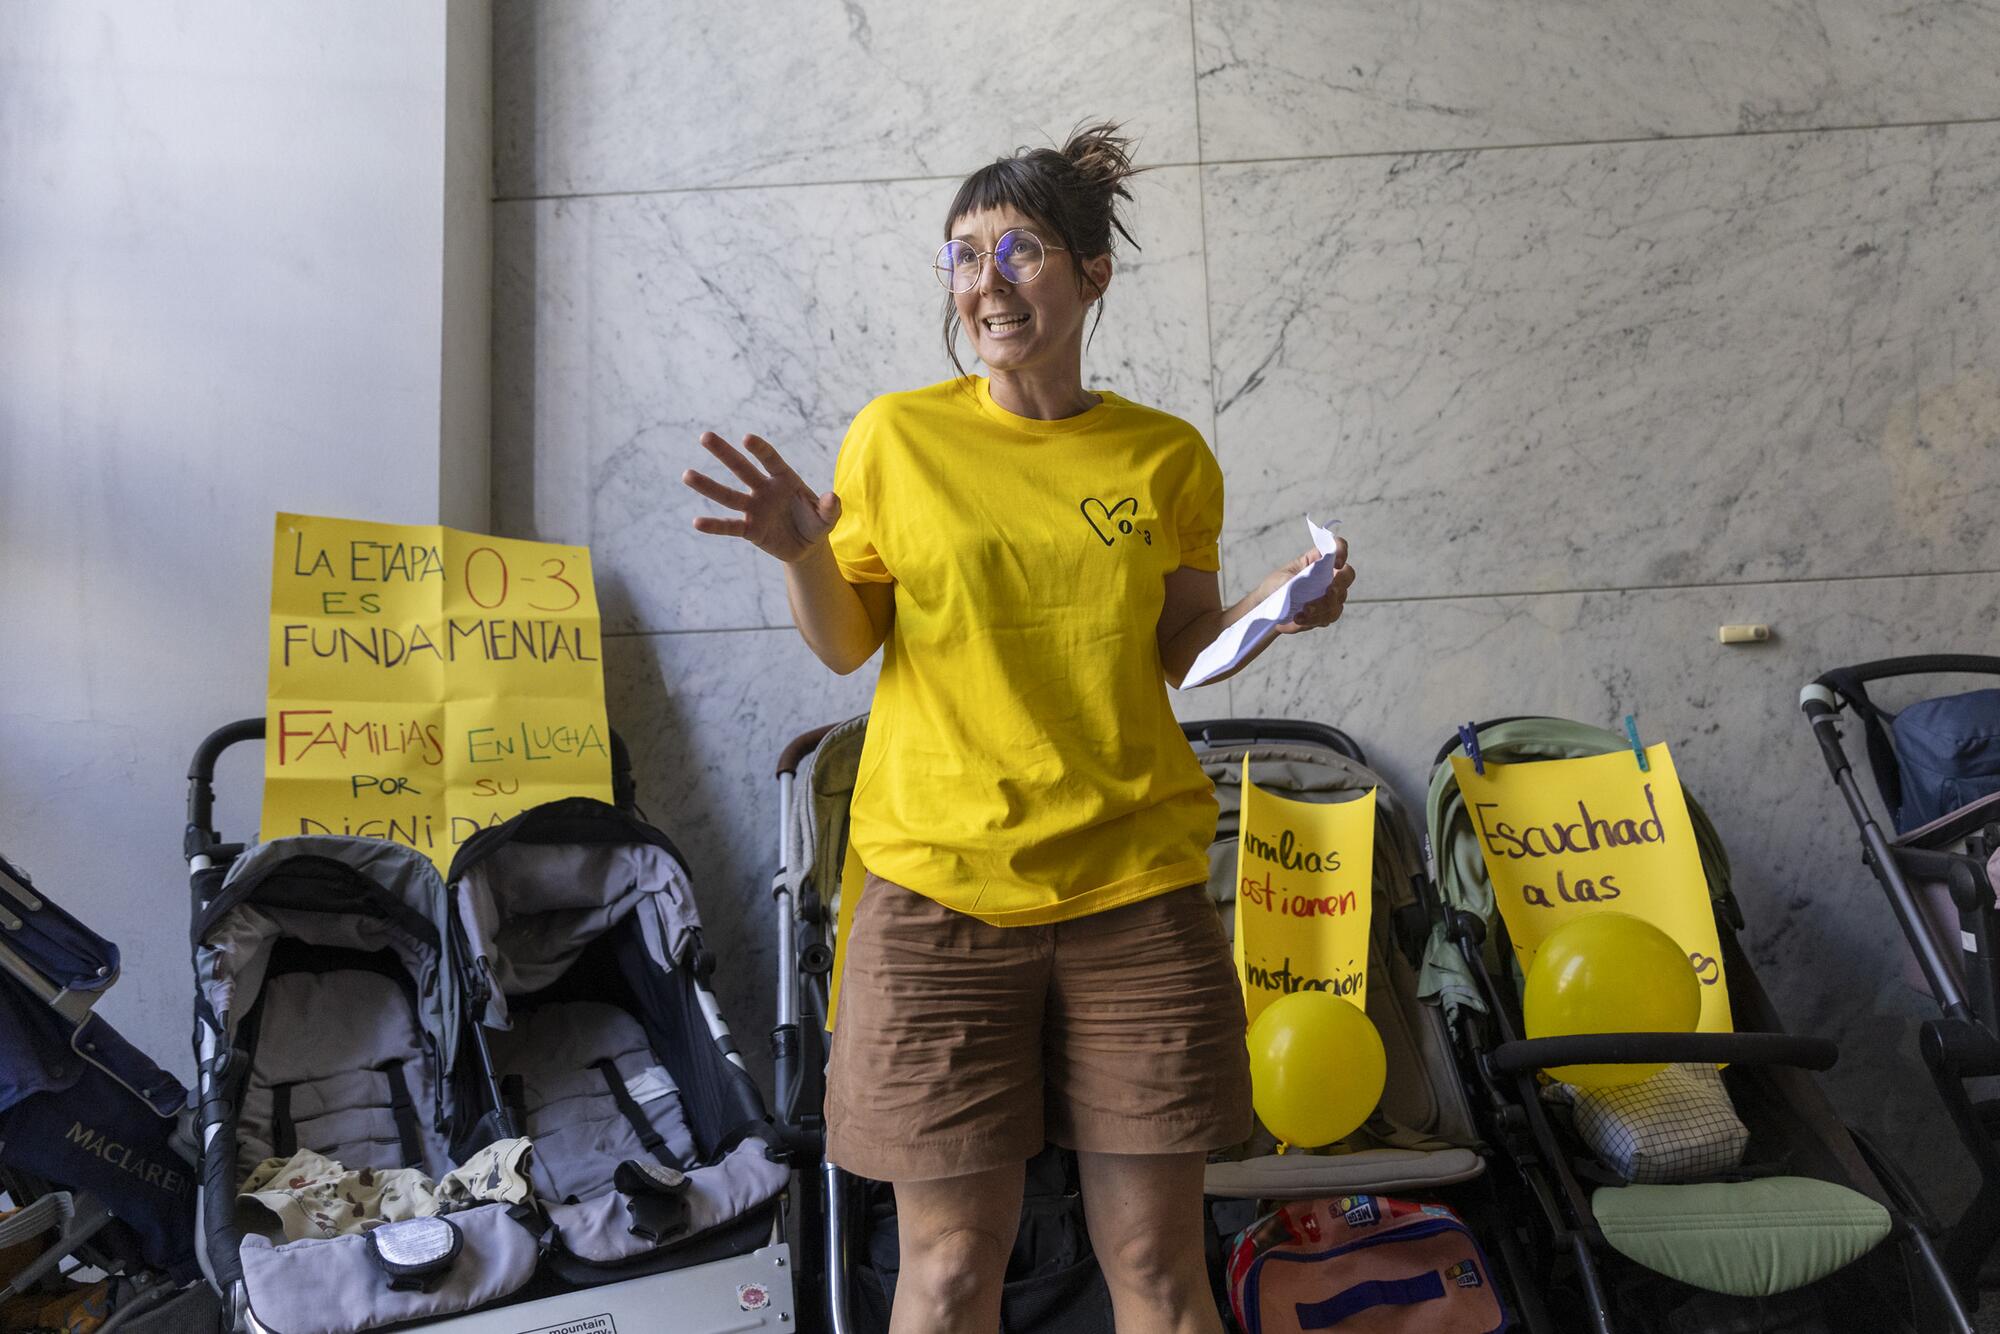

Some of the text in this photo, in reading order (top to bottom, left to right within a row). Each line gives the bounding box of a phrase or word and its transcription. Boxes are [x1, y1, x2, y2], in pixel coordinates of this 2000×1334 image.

[294, 531, 335, 578] LA
[351, 540, 446, 582] ETAPA
[322, 591, 381, 614] ES
[351, 774, 519, 799] POR SU
[1475, 783, 1665, 859] Escuchad
[1522, 870, 1621, 908] a las
[65, 1121, 190, 1193] MACLAREN
[549, 1318, 606, 1334] mountain
